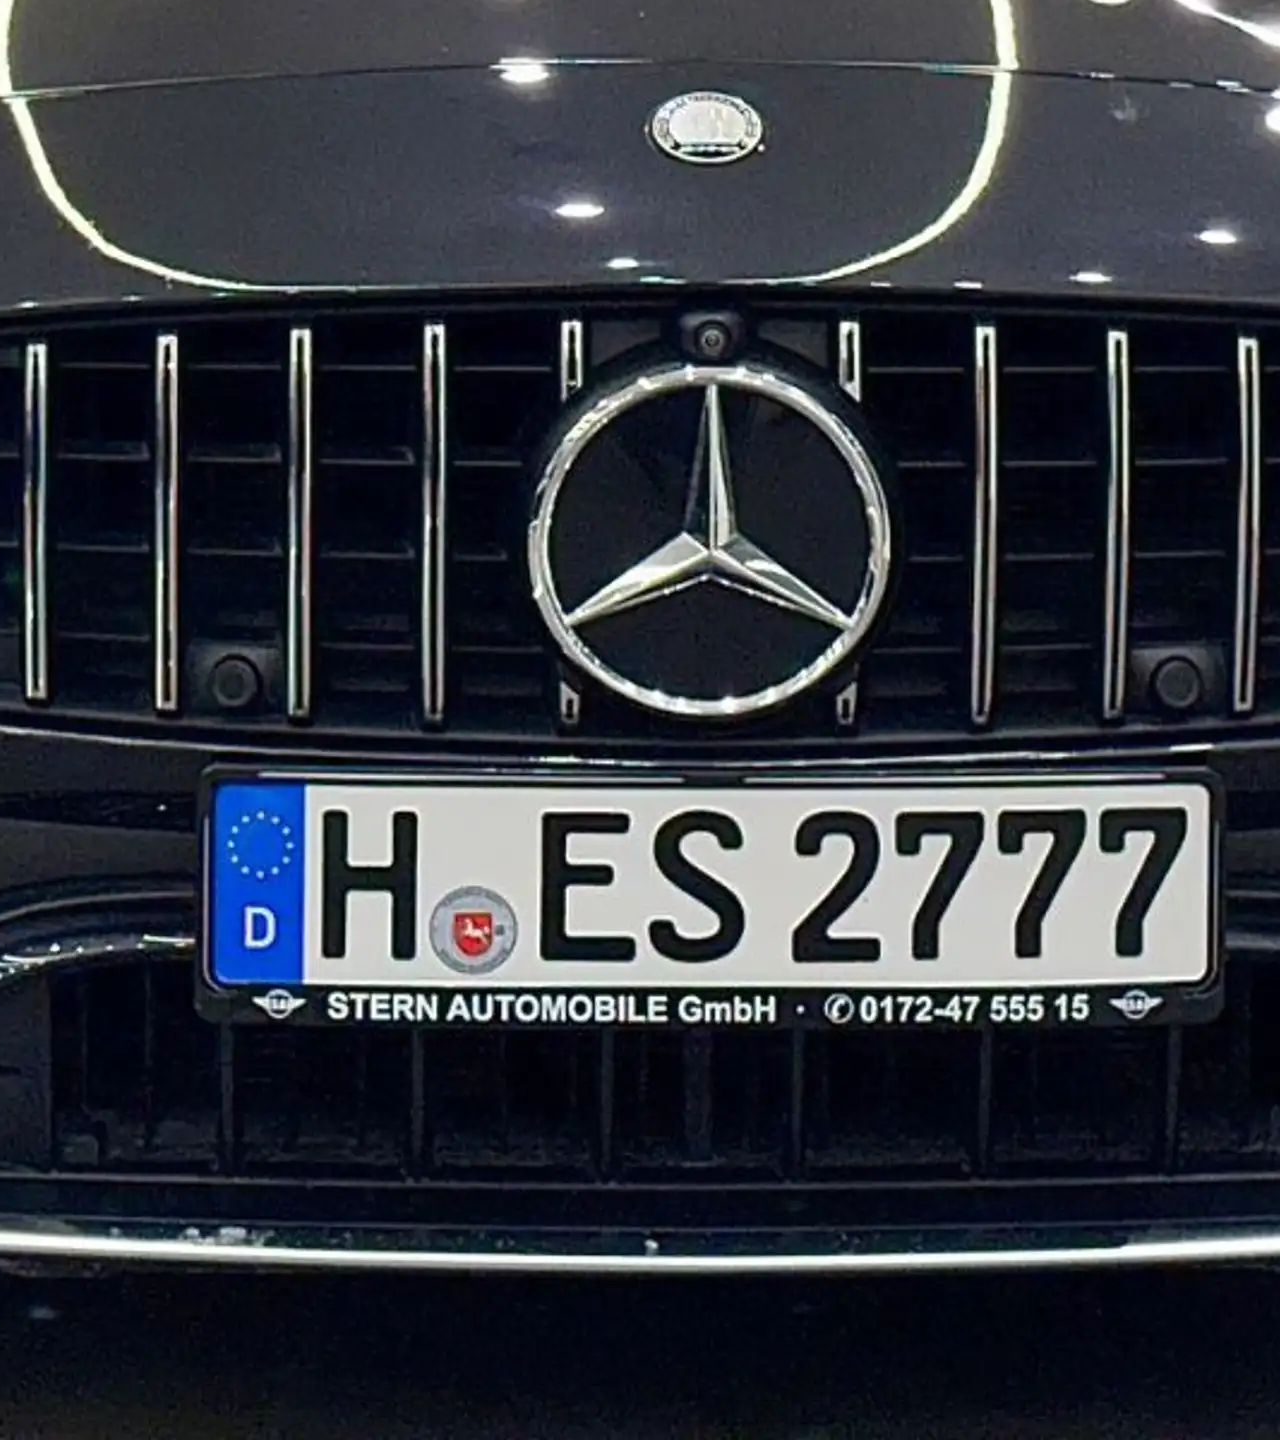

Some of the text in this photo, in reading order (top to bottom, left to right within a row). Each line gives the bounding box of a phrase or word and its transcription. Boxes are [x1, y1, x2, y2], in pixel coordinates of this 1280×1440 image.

[320, 809, 418, 961] H
[539, 810, 746, 964] ES
[791, 807, 1189, 963] 2777
[244, 905, 276, 949] D
[327, 991, 440, 1023] STERN
[445, 992, 668, 1023] AUTOMOBILE
[677, 993, 777, 1024] GmbH
[858, 994, 981, 1024] 0172-47
[988, 993, 1045, 1023] 555
[1053, 992, 1091, 1022] 15
